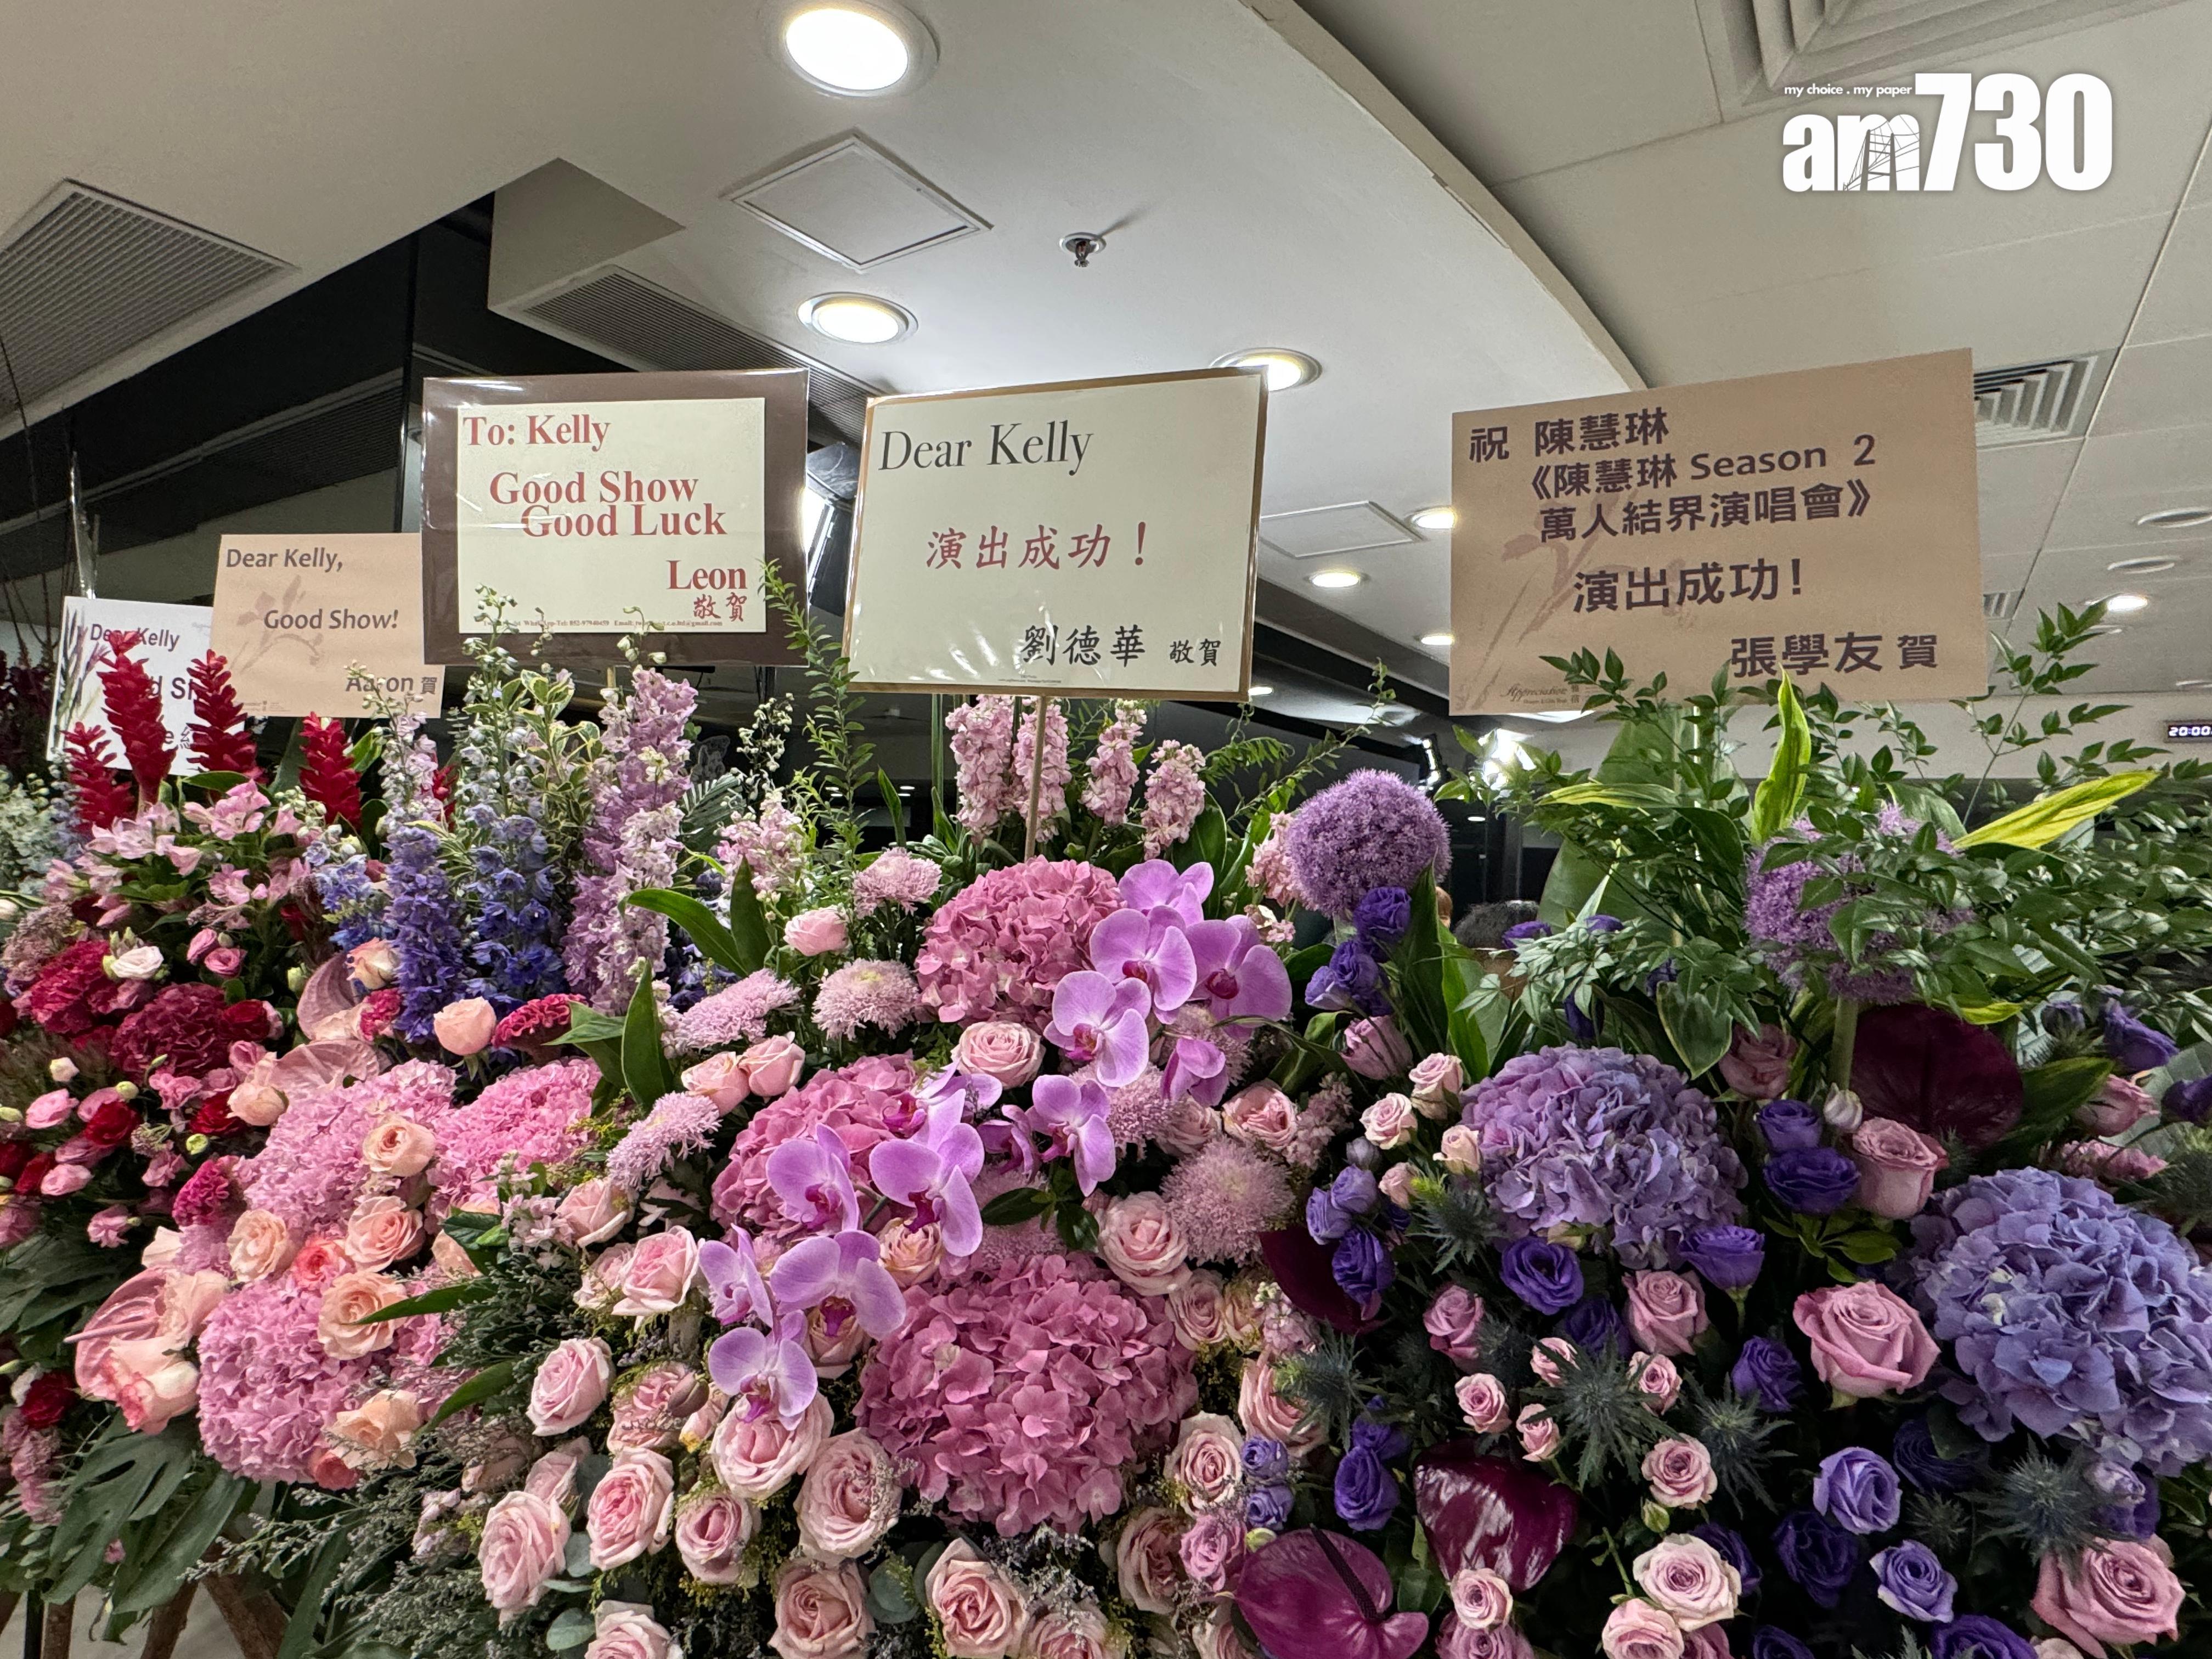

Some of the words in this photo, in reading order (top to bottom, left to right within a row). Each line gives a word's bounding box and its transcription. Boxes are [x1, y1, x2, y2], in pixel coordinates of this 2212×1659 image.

[462, 416, 515, 446] To:
[526, 414, 611, 452] Kelly
[878, 430, 973, 471] Dear
[987, 420, 1094, 476] Kelly
[1469, 426, 1510, 462] 祝
[1534, 407, 1669, 456] 陳慧琳
[1531, 454, 1678, 500] 《陳慧琳
[1690, 447, 1827, 480] Season
[1853, 435, 1876, 466] 2
[489, 472, 586, 505] Good
[599, 470, 699, 503] Show
[521, 505, 618, 537] Good
[630, 503, 728, 535] Luck
[1540, 479, 1871, 543] 萬人結界演唱會》
[226, 549, 278, 568] Dear
[284, 548, 343, 572] Kelly,
[925, 522, 1147, 569] 演出成功！
[666, 560, 748, 590] Leon
[1573, 558, 1802, 613] 演出成功!
[264, 609, 323, 629] Good
[329, 609, 399, 629] Show!
[693, 592, 747, 622] 敬賀
[90, 623, 133, 641] De
[137, 627, 180, 652] Kelly
[1022, 624, 1146, 667] 劉德華
[1169, 638, 1221, 667] 敬賀
[1731, 631, 1883, 678] 張學友
[1898, 634, 1938, 670] 賀
[421, 676, 438, 695] 賀
